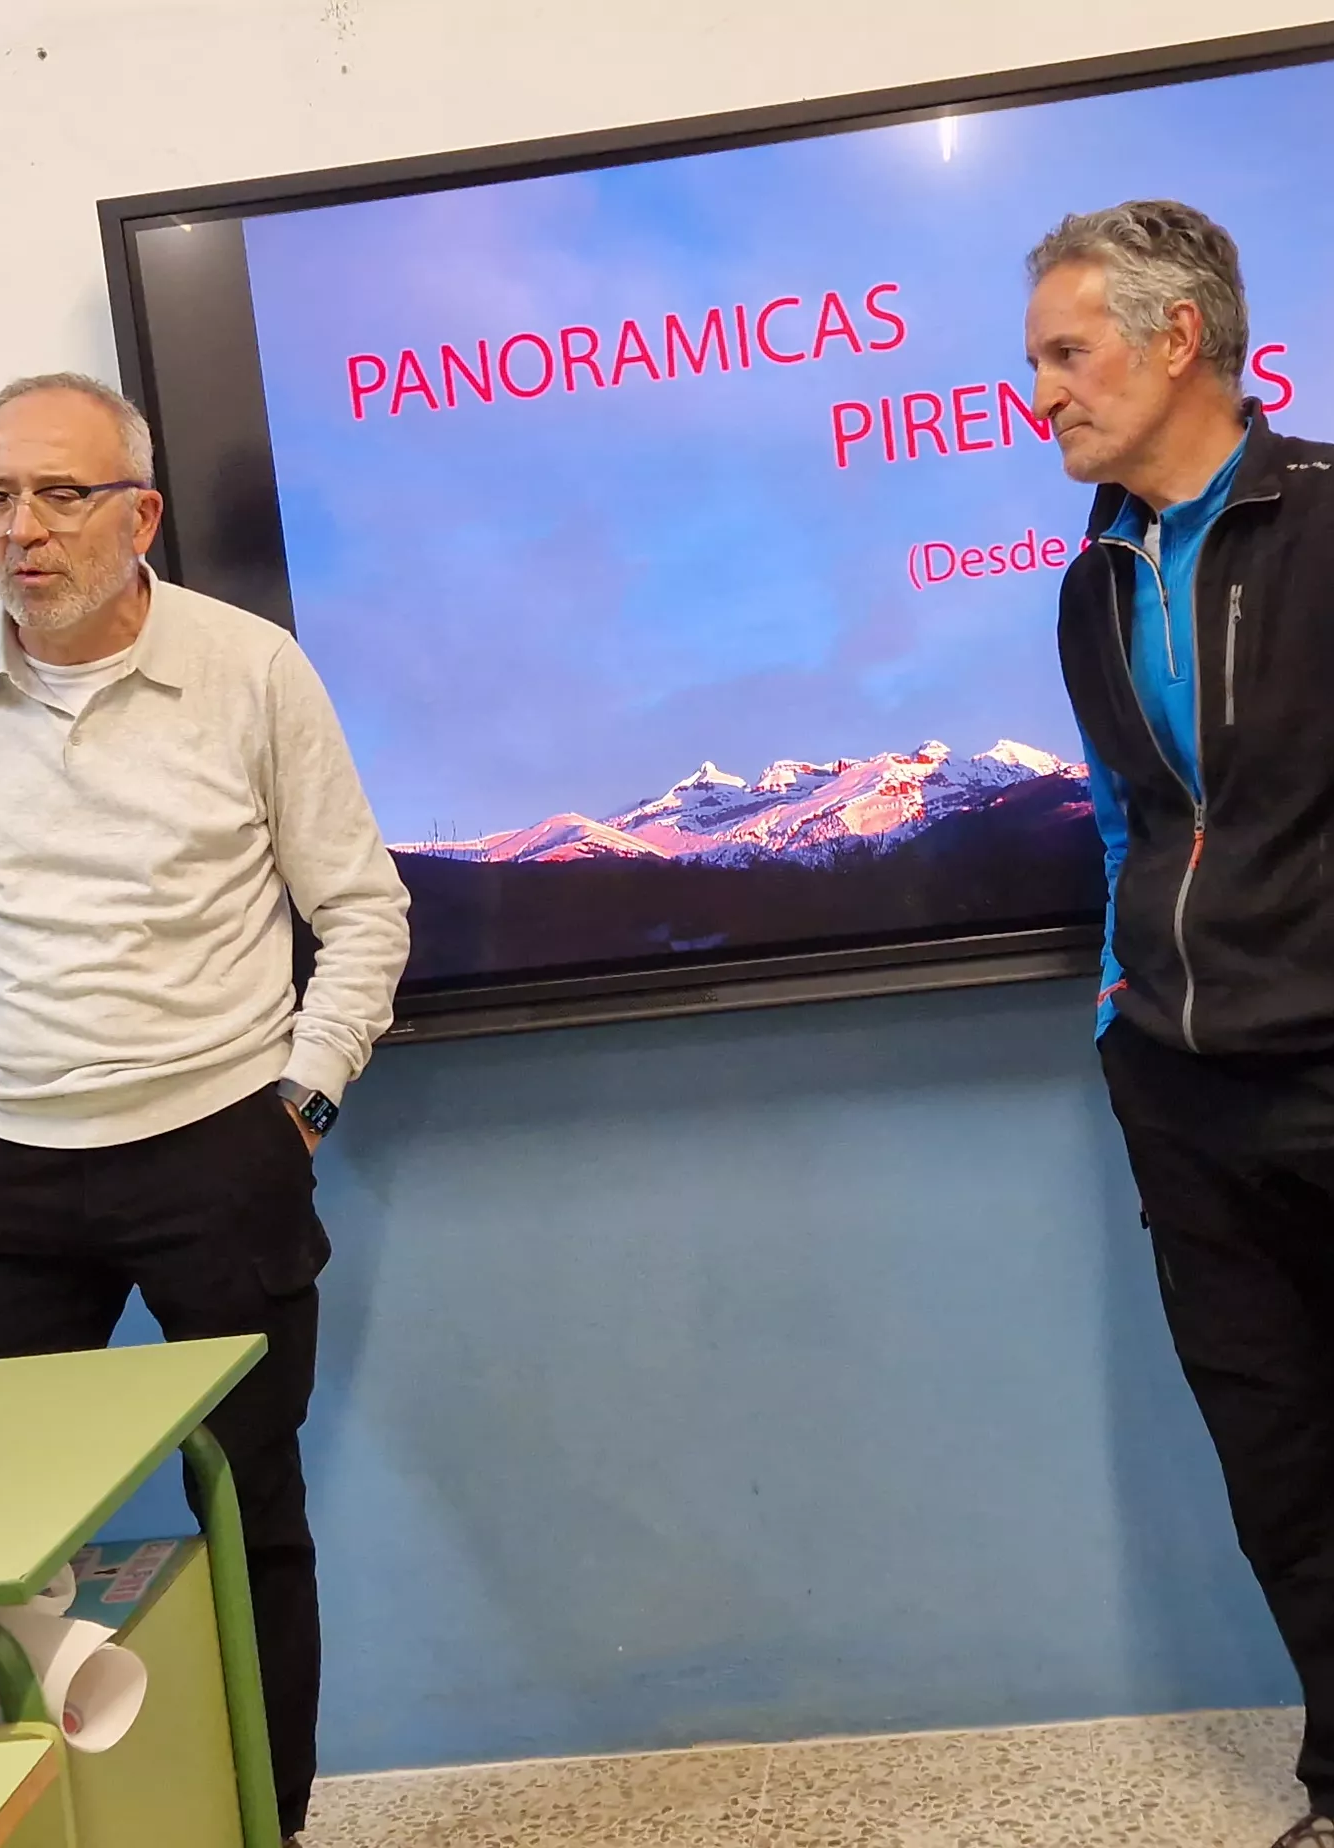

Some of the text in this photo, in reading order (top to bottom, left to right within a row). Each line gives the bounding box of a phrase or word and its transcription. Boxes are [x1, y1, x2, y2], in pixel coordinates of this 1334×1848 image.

[346, 282, 907, 421] PANORAMICAS
[831, 343, 1294, 469] PIRENS
[908, 528, 1067, 591] (Desde
